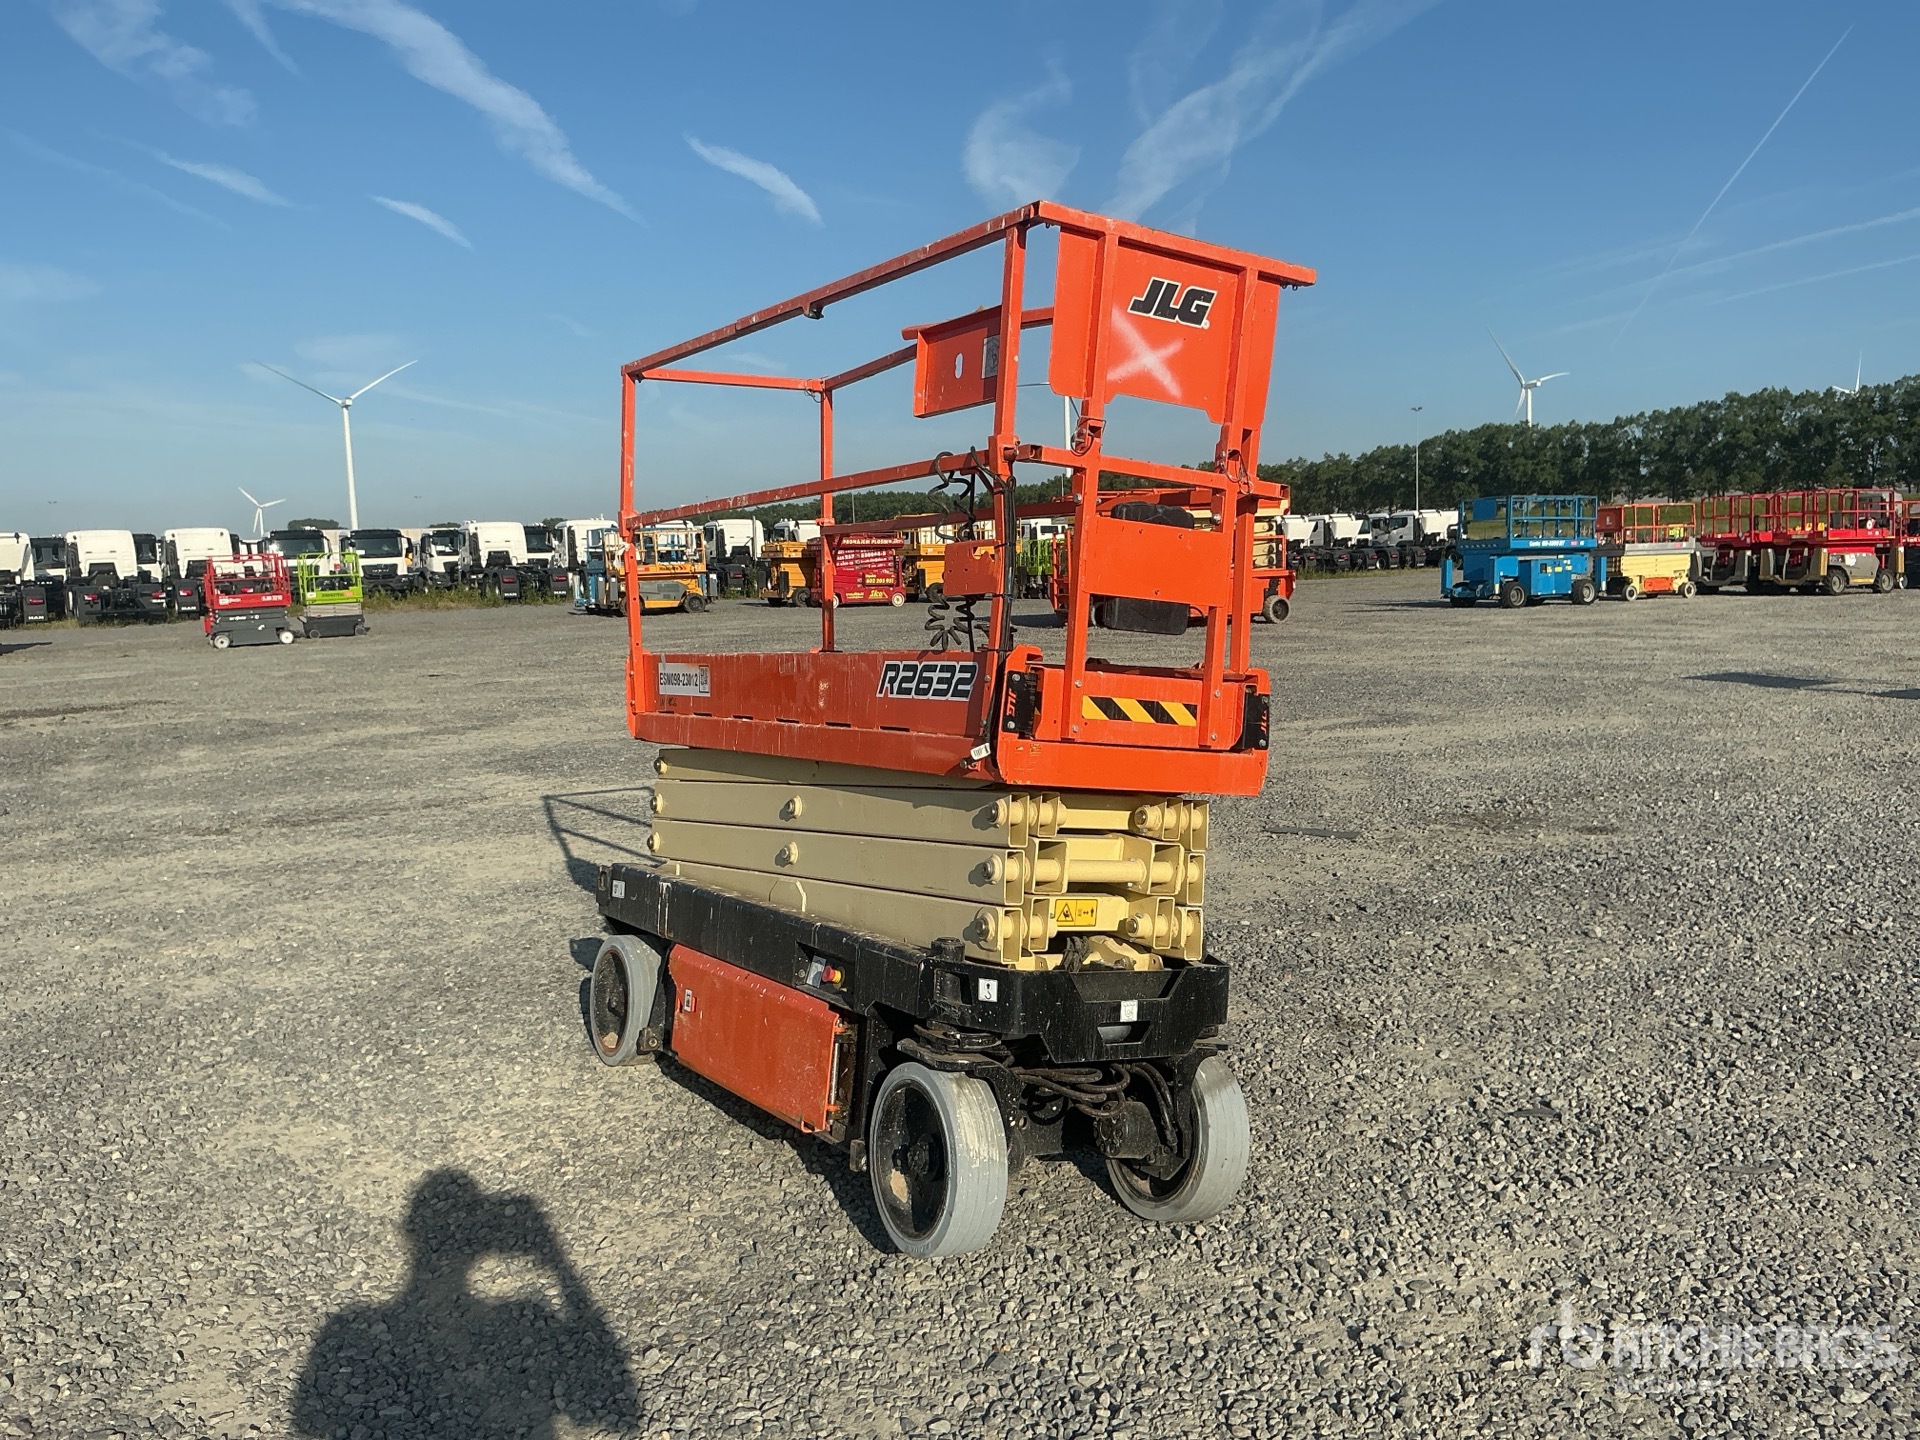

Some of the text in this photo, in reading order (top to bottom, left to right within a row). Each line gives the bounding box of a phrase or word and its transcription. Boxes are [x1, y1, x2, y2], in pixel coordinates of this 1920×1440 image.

[1128, 277, 1216, 328] JLG
[878, 661, 978, 701] R2632
[1006, 687, 1017, 717] JLG
